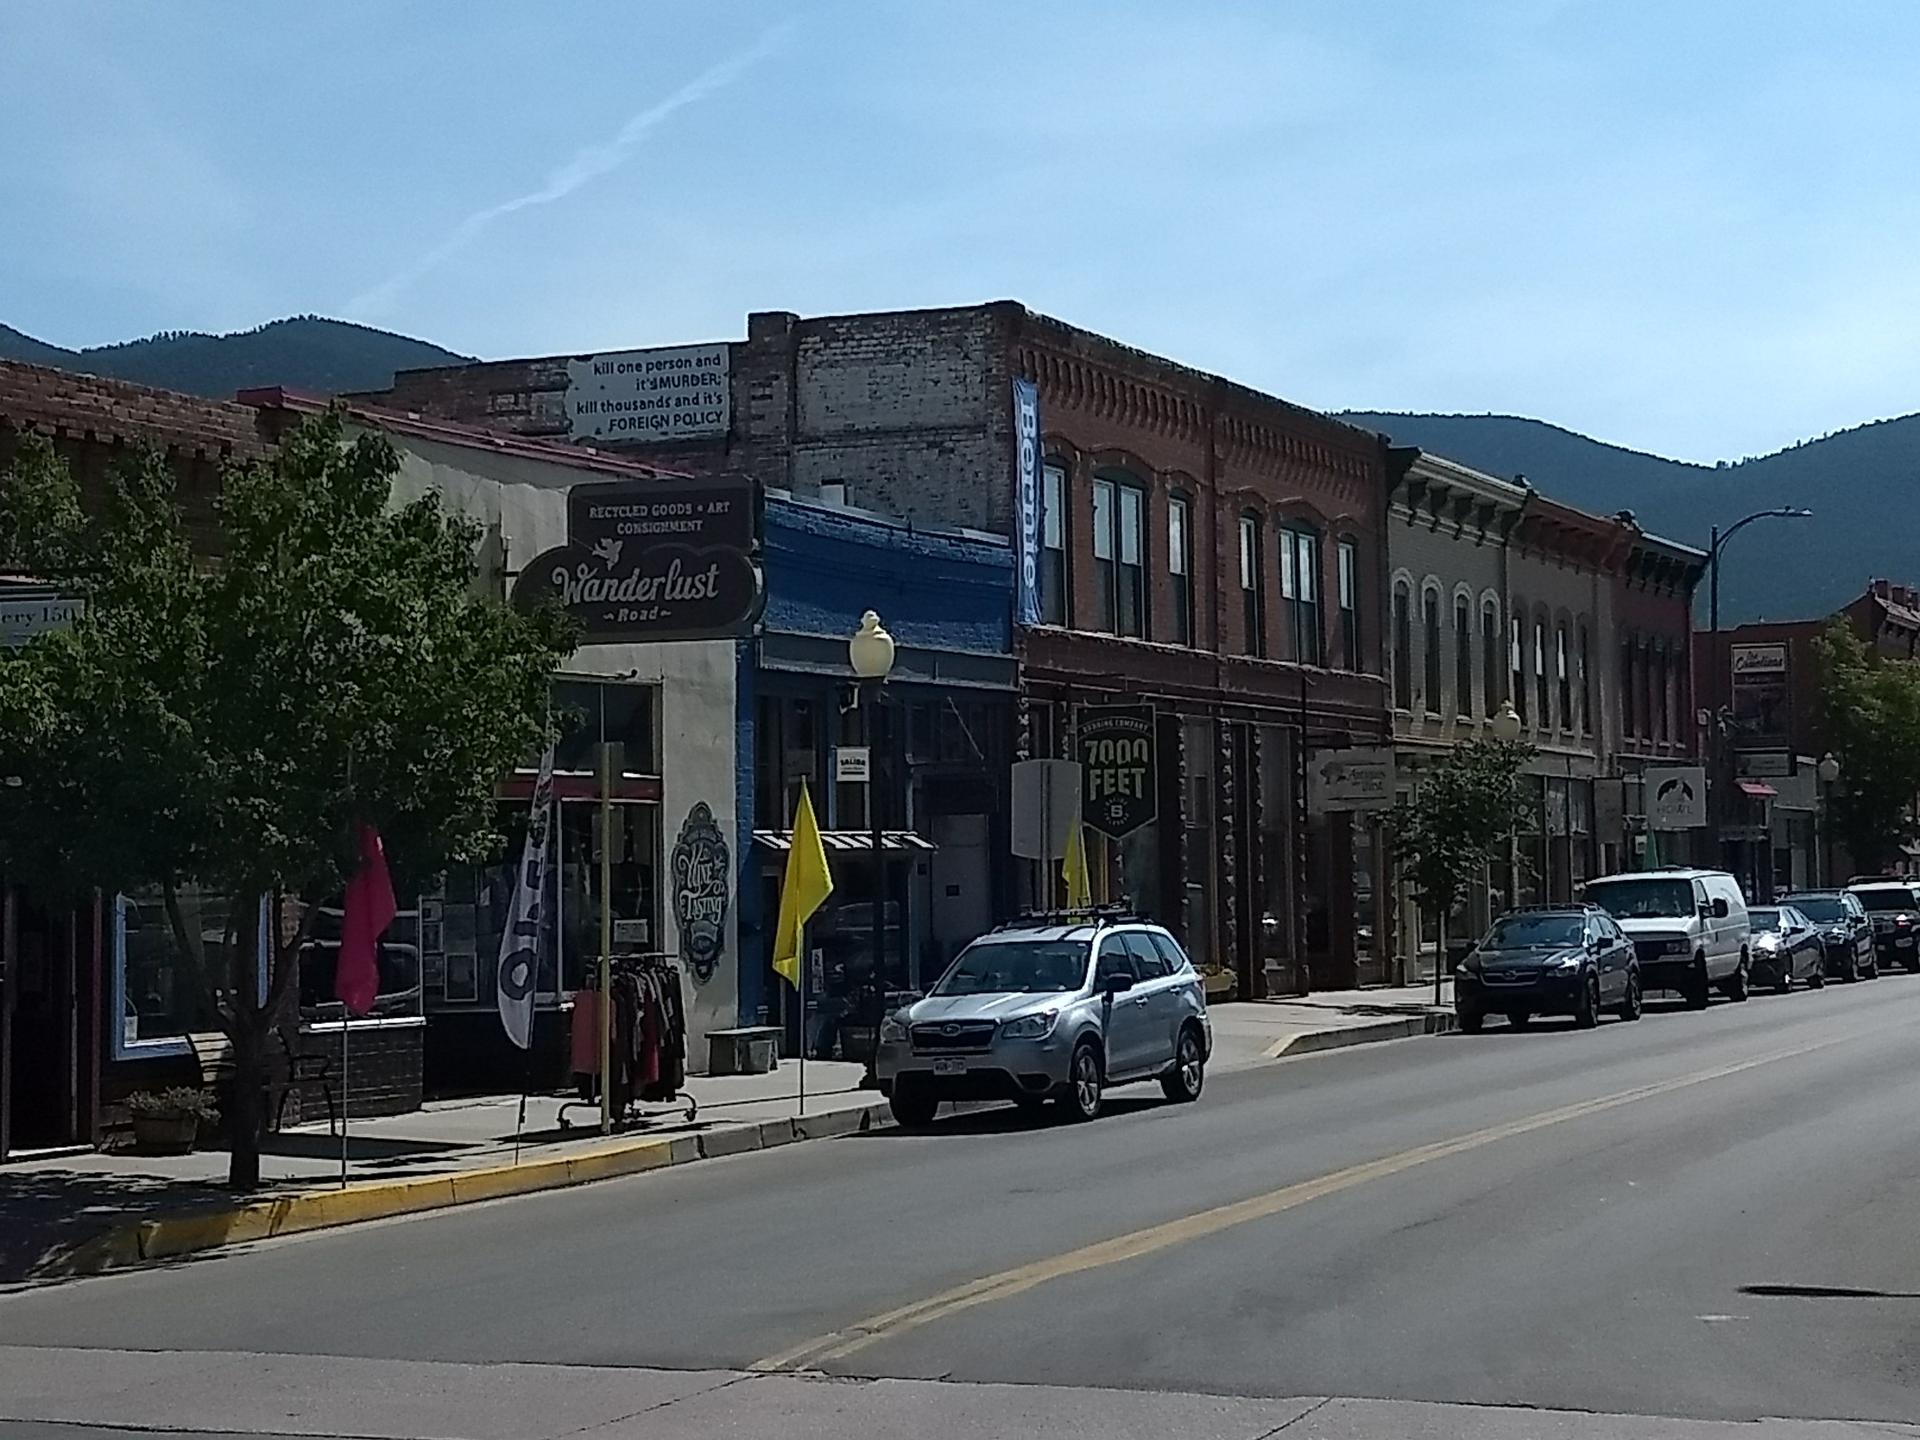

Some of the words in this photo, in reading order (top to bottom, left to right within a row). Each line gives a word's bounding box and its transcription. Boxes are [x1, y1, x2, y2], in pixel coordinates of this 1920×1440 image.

[594, 362, 614, 375] kill
[617, 363, 643, 374] one
[646, 358, 692, 374] person
[695, 353, 721, 368] and
[636, 378, 657, 391] it's
[576, 401, 598, 415] kill
[601, 396, 670, 414] thousands
[675, 391, 700, 408] and
[703, 391, 723, 405] it's
[609, 414, 670, 432] FOREIGN
[673, 411, 723, 427] POLICY
[1020, 402, 1037, 589] Bernie
[588, 504, 649, 519] RECYCLED
[651, 503, 693, 518] GOODS
[706, 501, 731, 514] ART
[616, 519, 704, 536] CONSIGNMENT
[551, 558, 720, 606] Wanderlust
[1084, 738, 1149, 767] 7000
[1089, 767, 1147, 801] FEET
